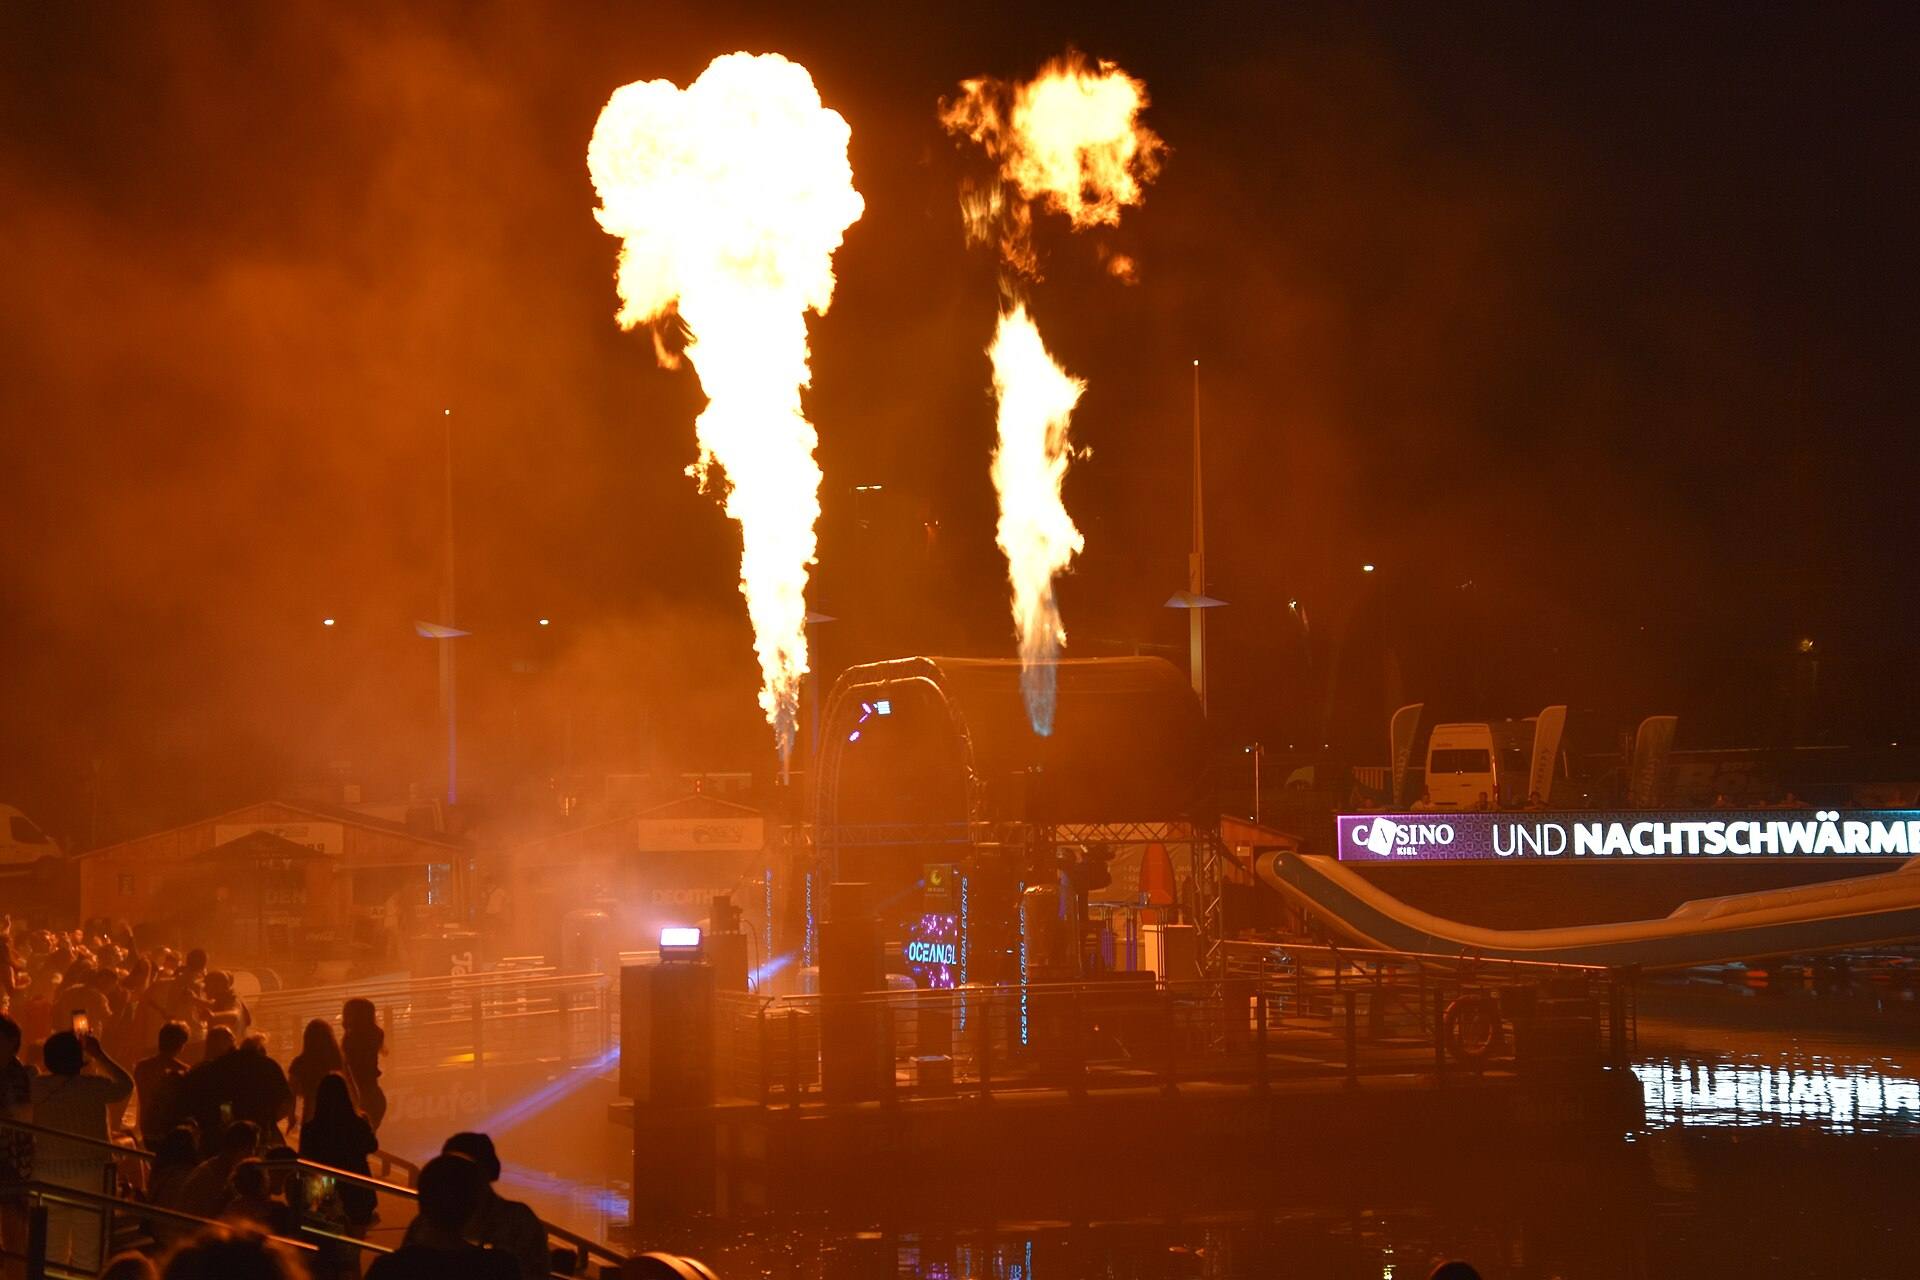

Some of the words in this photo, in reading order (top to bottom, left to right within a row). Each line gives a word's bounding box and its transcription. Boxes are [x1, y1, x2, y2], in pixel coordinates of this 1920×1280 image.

[1351, 818, 1454, 854] CASINO
[1493, 823, 1567, 856] UND
[1573, 810, 1920, 855] NACHTSCHWÄRME
[1397, 847, 1418, 856] KIEL
